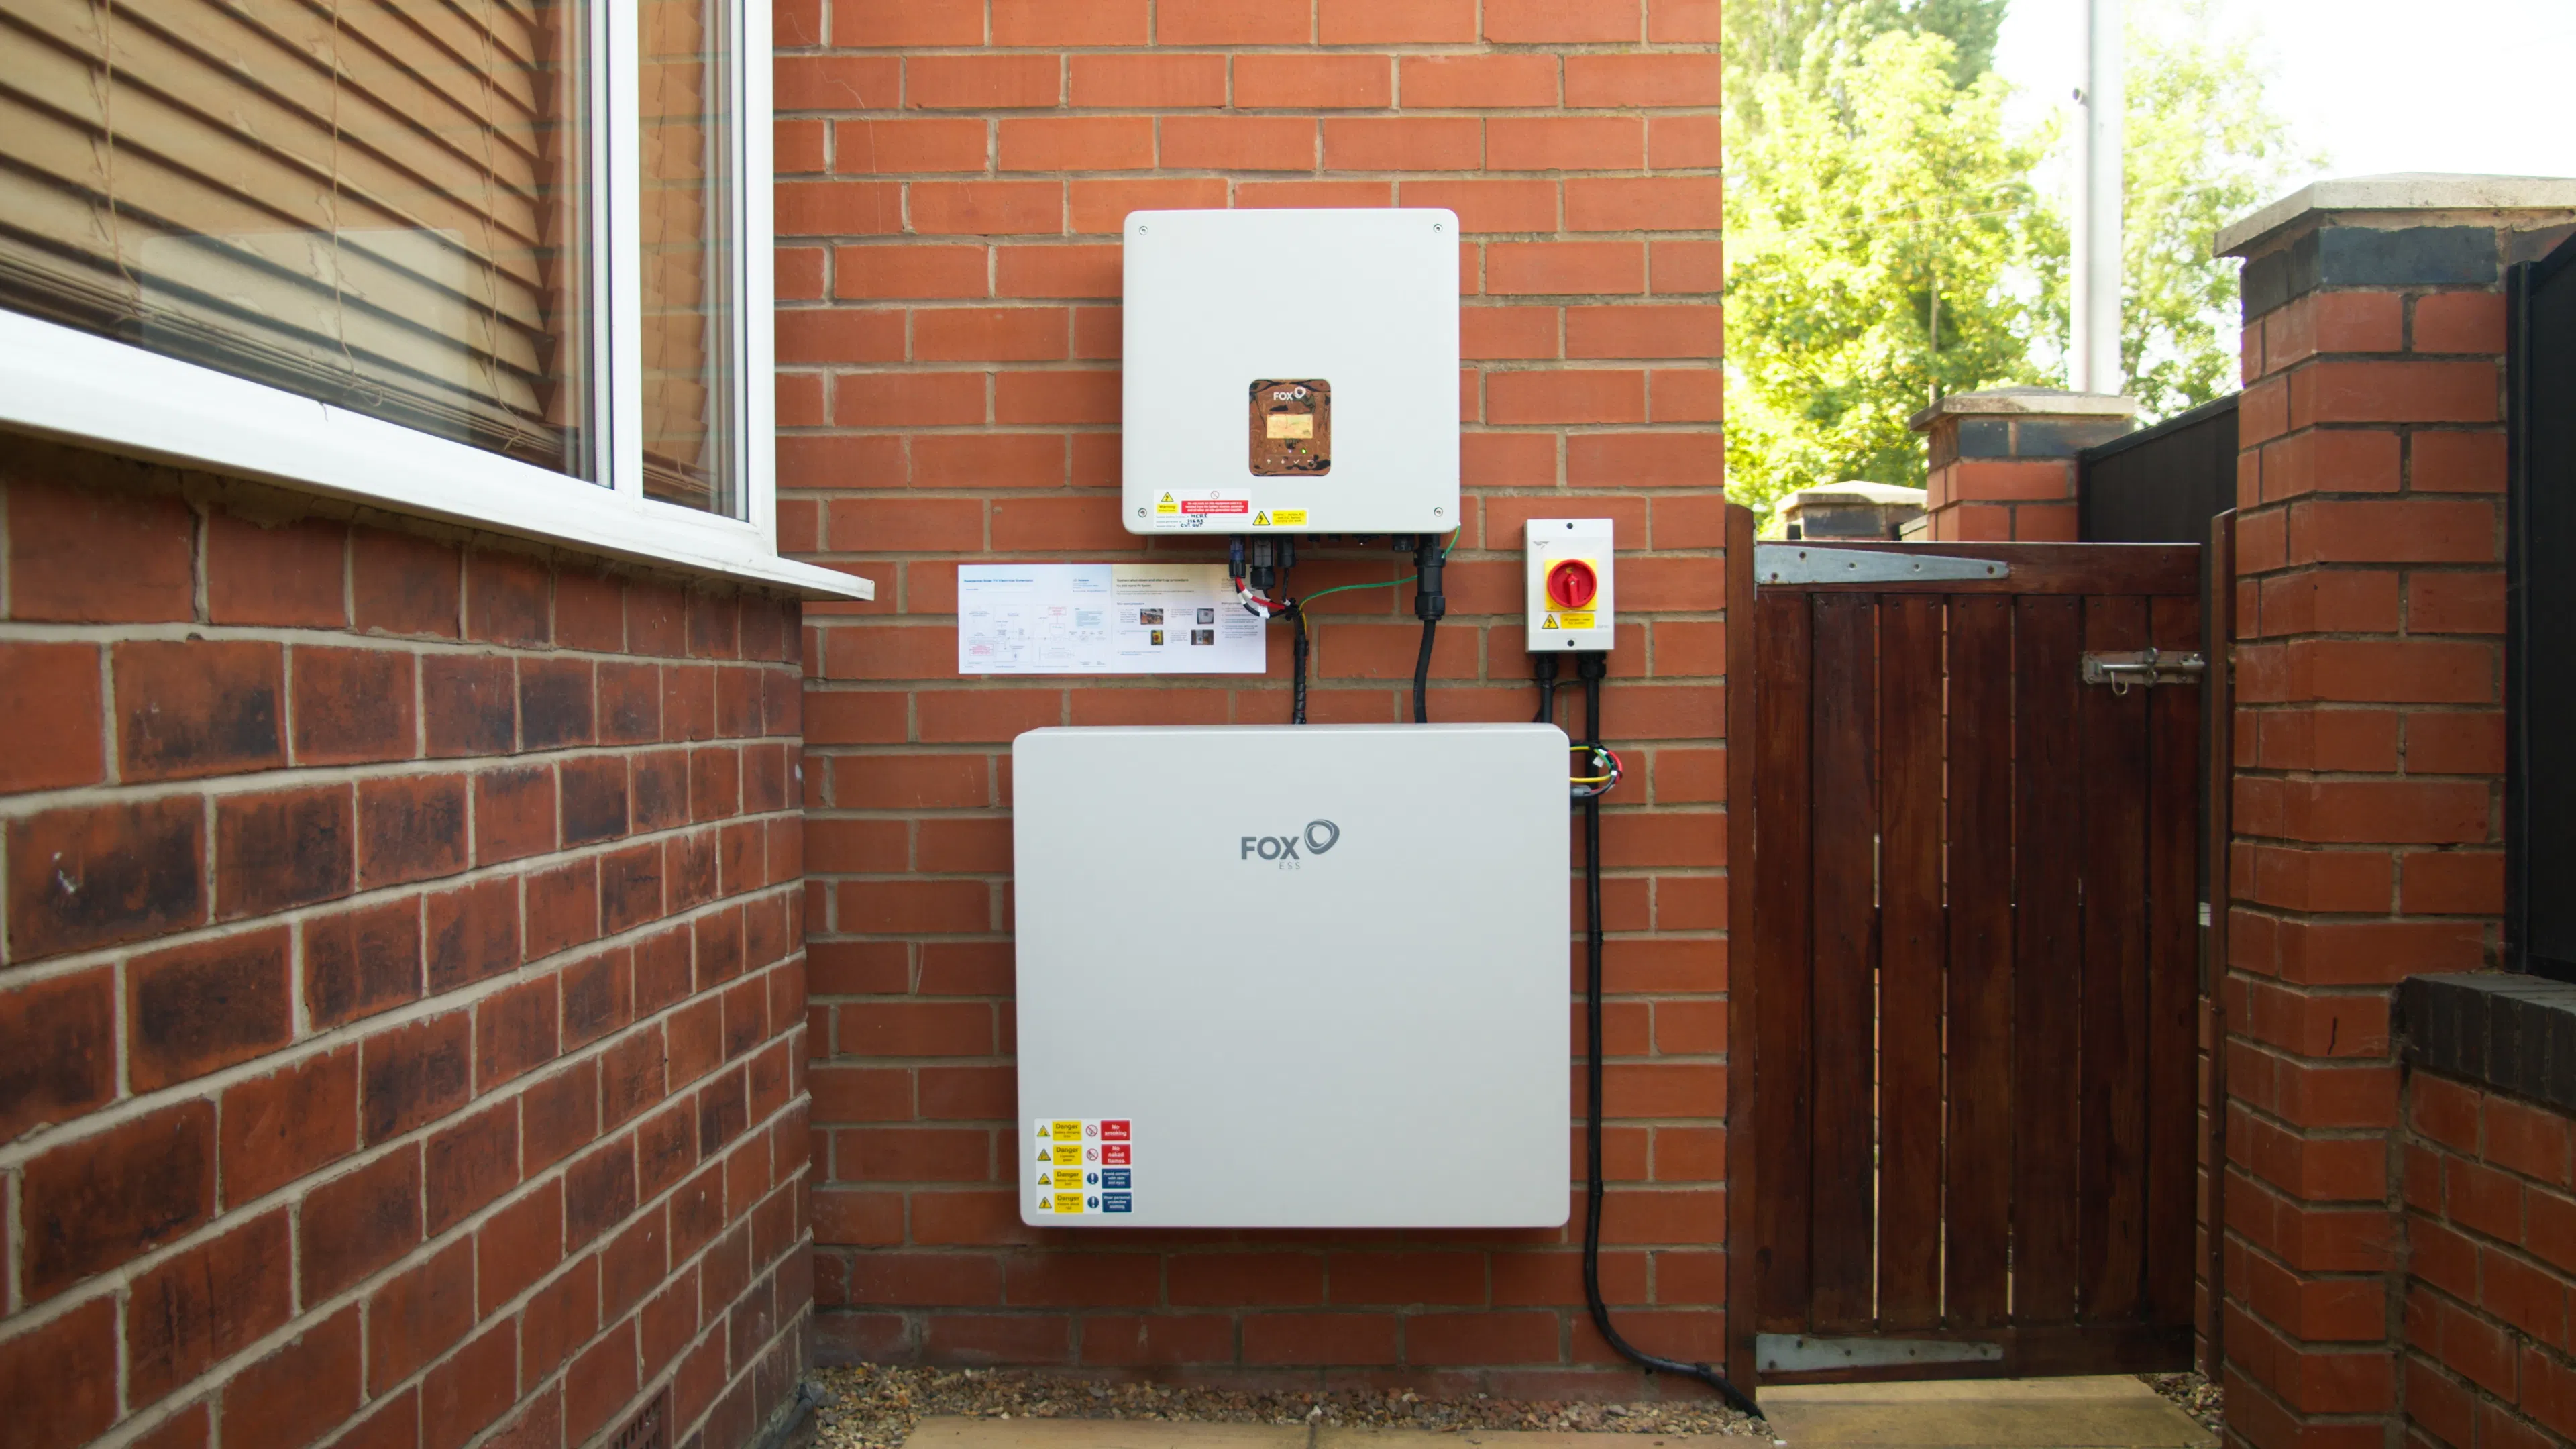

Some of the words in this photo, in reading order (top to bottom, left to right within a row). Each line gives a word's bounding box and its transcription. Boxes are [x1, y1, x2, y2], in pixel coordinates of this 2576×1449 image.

[1273, 392, 1293, 401] FOX
[1241, 836, 1300, 860] FOX
[1279, 861, 1300, 870] ESS
